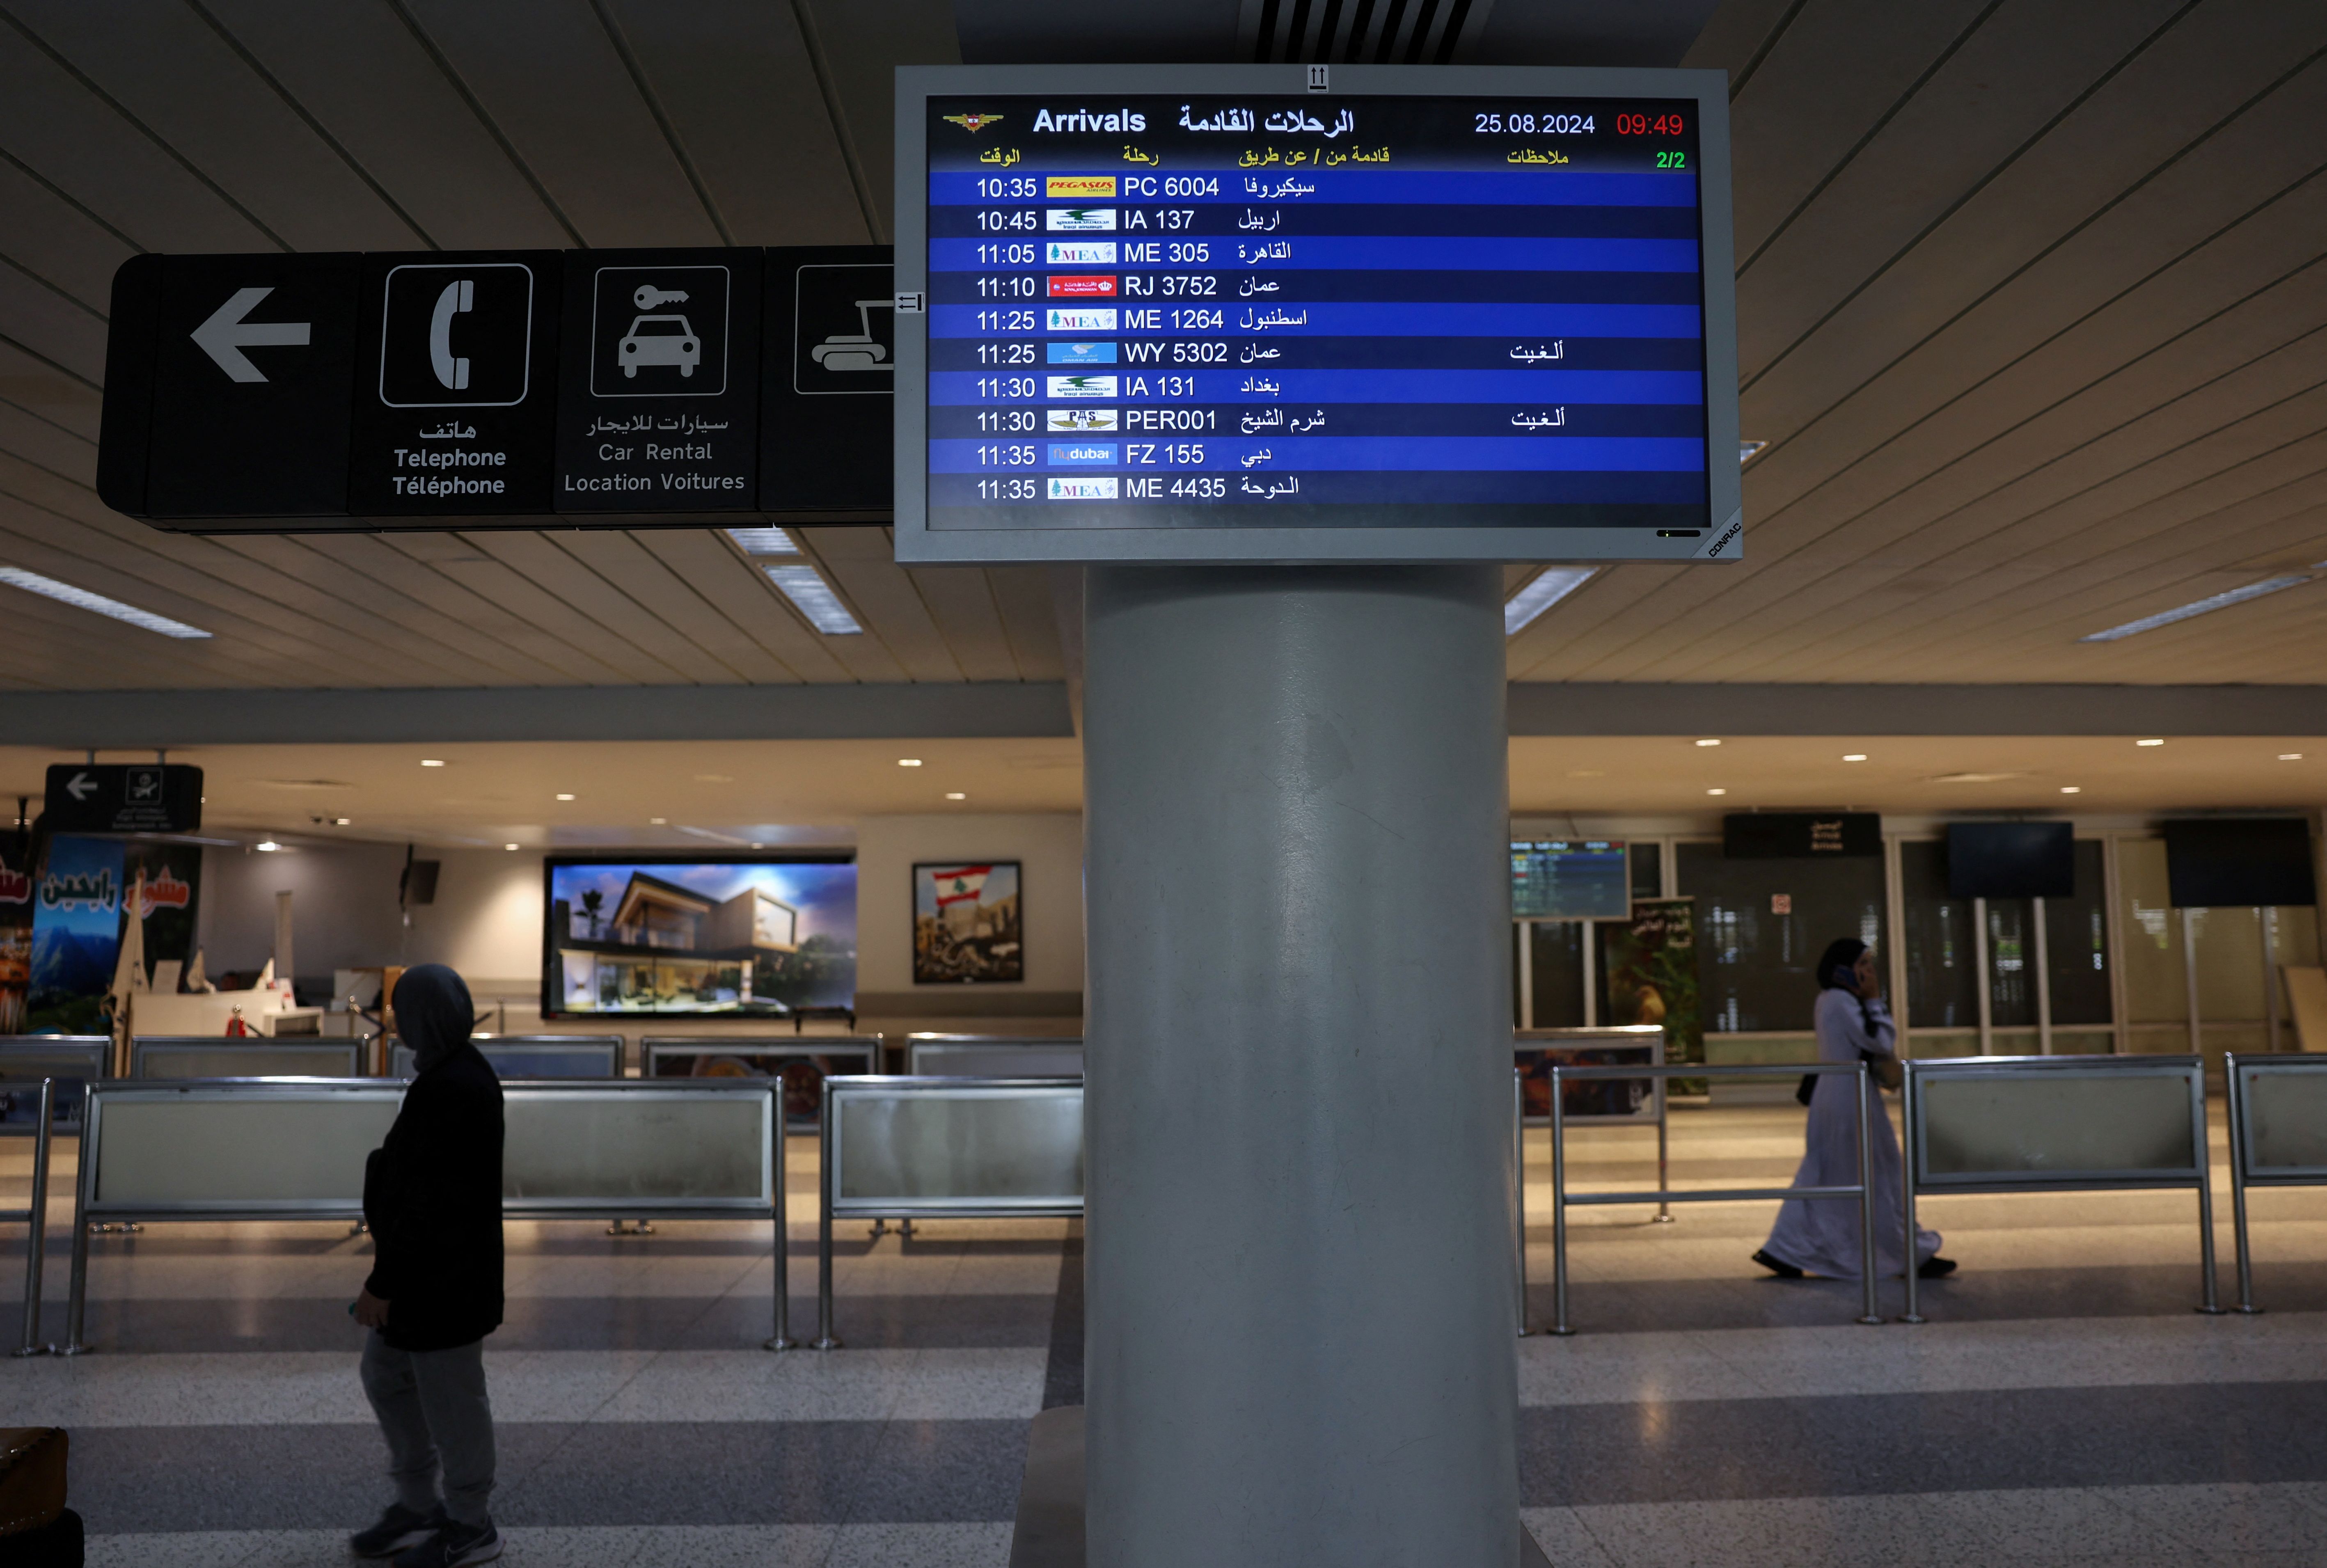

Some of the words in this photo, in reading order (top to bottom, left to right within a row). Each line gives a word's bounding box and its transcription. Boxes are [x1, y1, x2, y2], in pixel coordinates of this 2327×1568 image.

[1033, 109, 1145, 131] Arrivals
[1179, 105, 1254, 131] القادمة
[1265, 109, 1353, 138] الرحلات
[1476, 114, 1595, 133] 25.08.2024
[1617, 114, 1683, 135] 09:49
[980, 147, 1019, 167] الوقت
[1123, 145, 1158, 166] رحلة
[1239, 146, 1278, 167] طريق
[1285, 151, 1306, 165] عن
[1326, 151, 1346, 165] من
[1352, 146, 1389, 161] قادمة
[1507, 149, 1568, 164] ملاحظات
[1657, 152, 1684, 168] 2/2
[978, 179, 1036, 197] 10:35
[1125, 177, 1157, 196] PC
[1165, 177, 1218, 196] 6004
[978, 211, 1036, 230] 10:45
[1125, 211, 1147, 229] IA
[1156, 210, 1194, 229] 137
[1239, 208, 1279, 231] اربيل
[978, 245, 1034, 263] 11:05
[1062, 250, 1101, 261] MEA
[1125, 243, 1160, 262] ME
[1169, 243, 1209, 262] 305
[1239, 241, 1290, 263] القاهرة
[978, 277, 1034, 296] 11:10
[1126, 277, 1153, 295] RJ
[1163, 276, 1216, 295] 3752
[1240, 276, 1279, 296] عمان
[978, 311, 1035, 330] 11:25
[1062, 317, 1101, 327] MEA
[1126, 310, 1161, 328] ME
[1171, 310, 1223, 328] 1264
[1240, 308, 1306, 330] اسطنبول
[978, 344, 1035, 363] 11:25
[1125, 343, 1166, 362] WY
[1173, 343, 1227, 362] 5302
[1241, 343, 1280, 363] عمان
[978, 378, 1035, 397] 11:30
[1127, 377, 1148, 396] IA
[1158, 377, 1193, 396] 131
[1241, 376, 1280, 396] بغداد
[586, 415, 652, 436] للايجار
[657, 414, 728, 435] سيارات
[978, 412, 1035, 430] 11:30
[1127, 410, 1214, 429] PER001
[1241, 408, 1283, 433] الشيخ
[1291, 410, 1324, 433] شرم
[419, 421, 476, 438] هاتف
[394, 449, 506, 469] Telephone
[599, 444, 633, 460] Car
[647, 443, 712, 460] Rental
[978, 446, 1036, 465] 11:35
[1127, 444, 1155, 464] FZ
[1165, 444, 1204, 463] 155
[1241, 449, 1272, 467] دبي
[393, 476, 504, 497] Téléphone
[566, 474, 650, 491] Location
[661, 473, 744, 489] Voitures
[978, 480, 1035, 499] 11:35
[1063, 486, 1102, 496] MEA
[1127, 478, 1163, 497] ME
[1170, 478, 1225, 497] 4435
[1241, 476, 1298, 499] الدوحة
[1709, 522, 1742, 558] CONRAC
